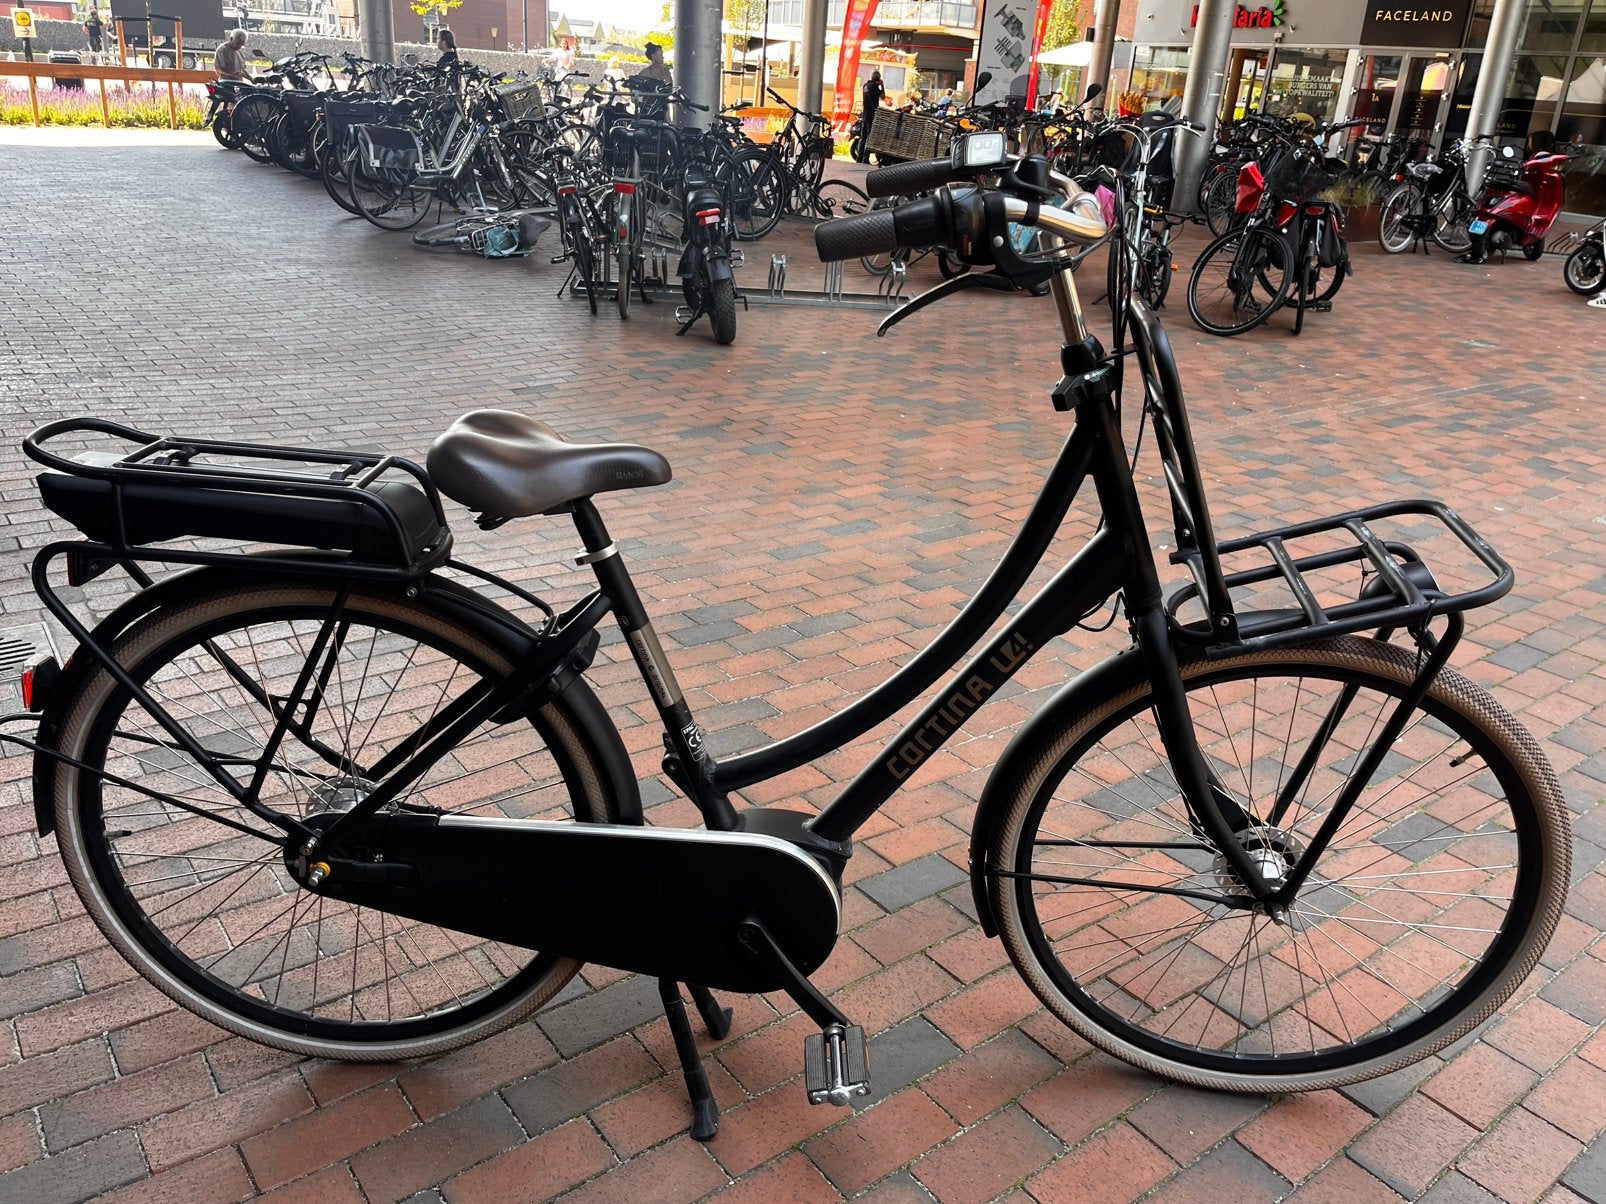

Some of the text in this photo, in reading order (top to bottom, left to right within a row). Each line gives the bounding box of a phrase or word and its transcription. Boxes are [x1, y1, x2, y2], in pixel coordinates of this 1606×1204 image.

[1375, 10, 1453, 22] FACELAND
[1318, 82, 1333, 90] VAN
[886, 674, 994, 780] CORTINA
